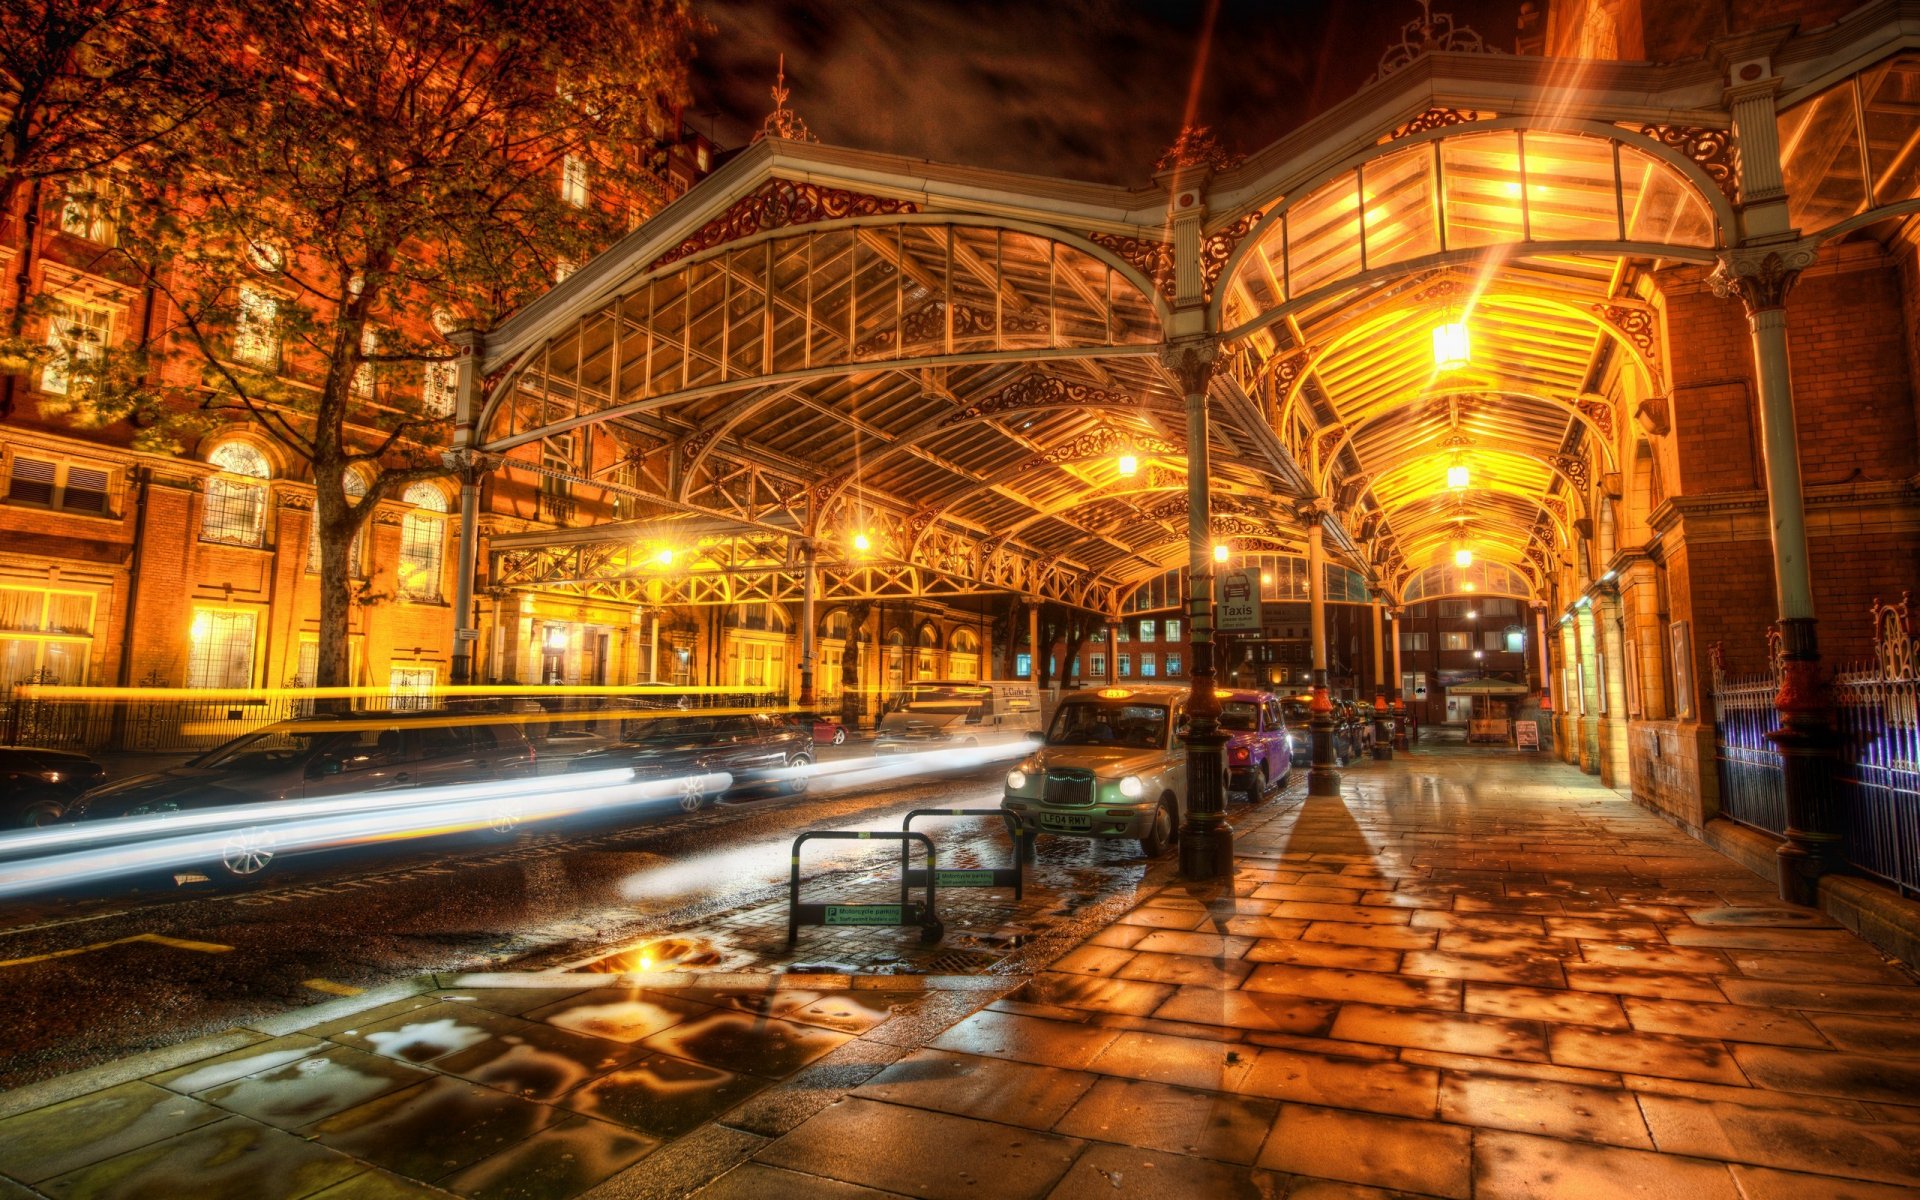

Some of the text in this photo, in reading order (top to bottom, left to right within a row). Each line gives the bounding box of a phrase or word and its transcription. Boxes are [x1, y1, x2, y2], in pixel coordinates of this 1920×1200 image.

[1222, 605, 1253, 616] Taxis
[1043, 814, 1086, 825] LF04 RMY
